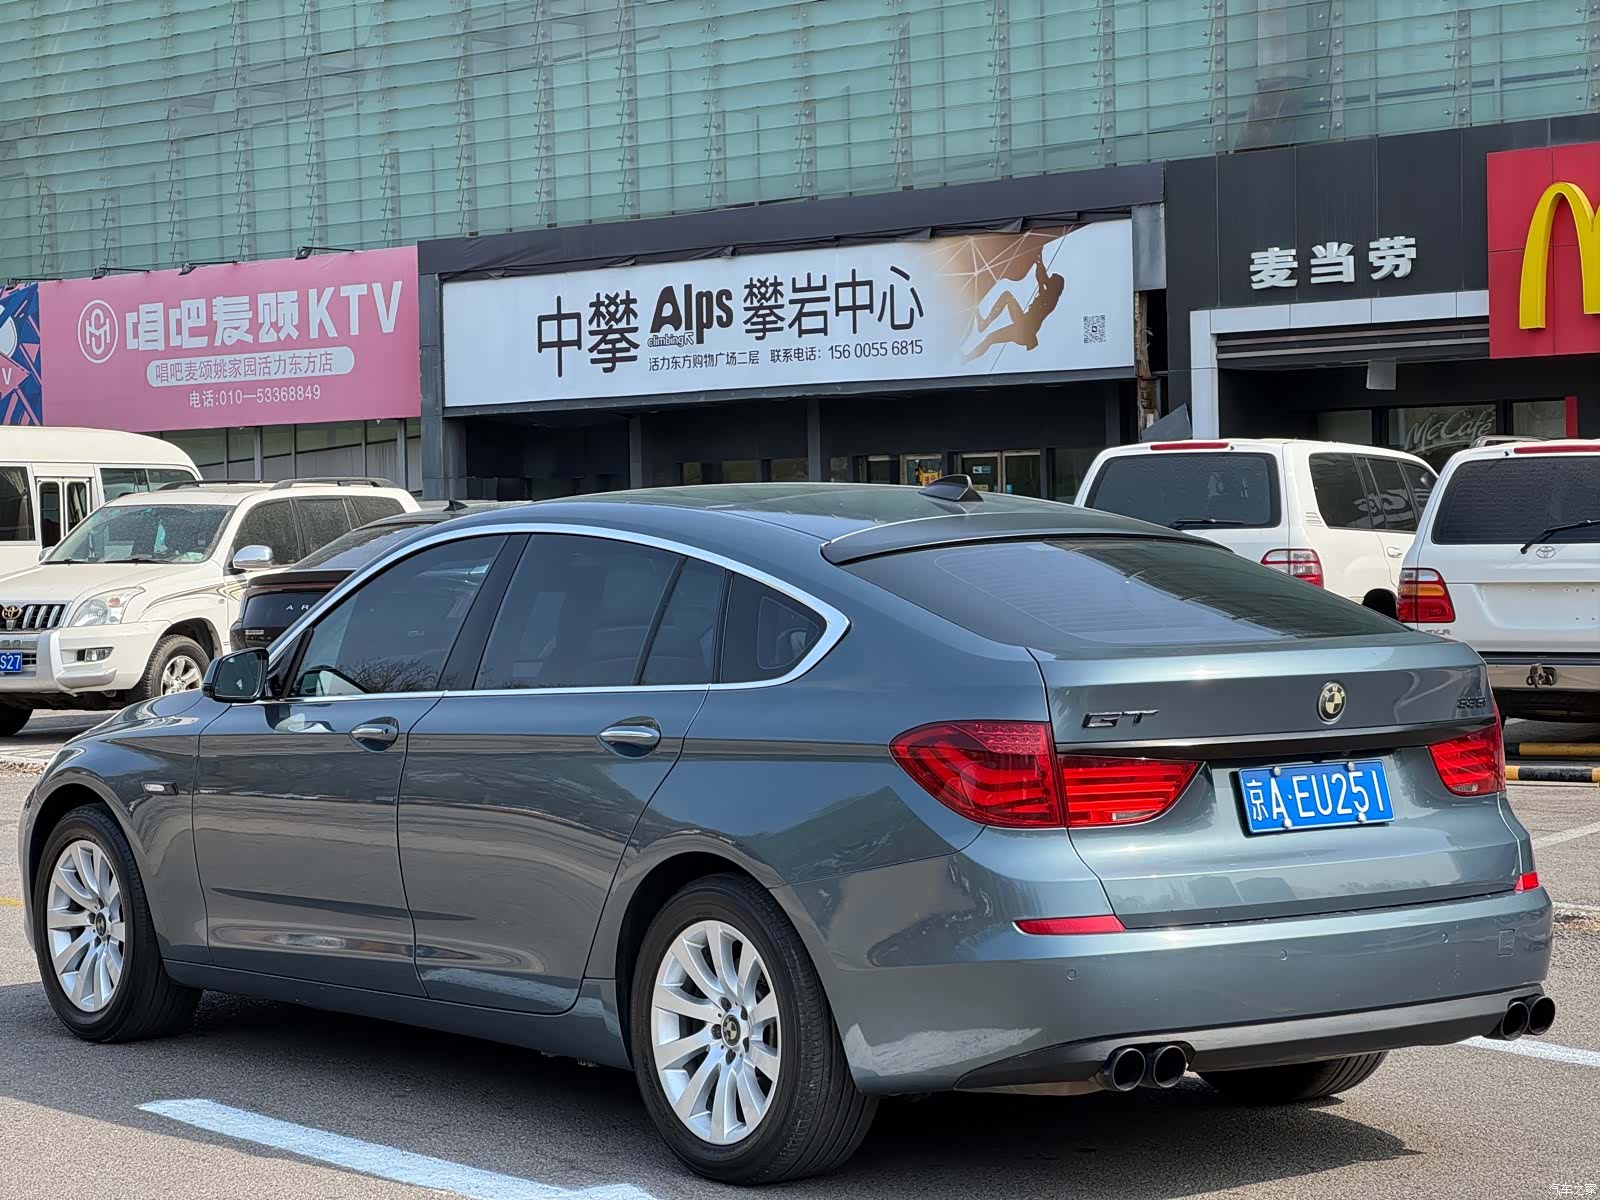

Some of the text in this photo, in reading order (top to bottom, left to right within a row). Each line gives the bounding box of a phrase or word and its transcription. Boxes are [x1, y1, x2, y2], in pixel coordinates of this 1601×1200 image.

[1249, 235, 1417, 290] 麦当劳
[125, 280, 403, 352] 唱吧麦颂 KTV
[537, 265, 925, 378] 中攀 Alps 攀岩中心
[647, 333, 685, 348] climbing
[648, 350, 760, 373] 活力东方购物广场二层
[827, 343, 851, 360] 156
[854, 341, 888, 358] 0055
[891, 339, 924, 356] 6815
[155, 350, 334, 384] 唱吧麦颂姚家园活力东方店
[1404, 408, 1494, 452] McCafé
